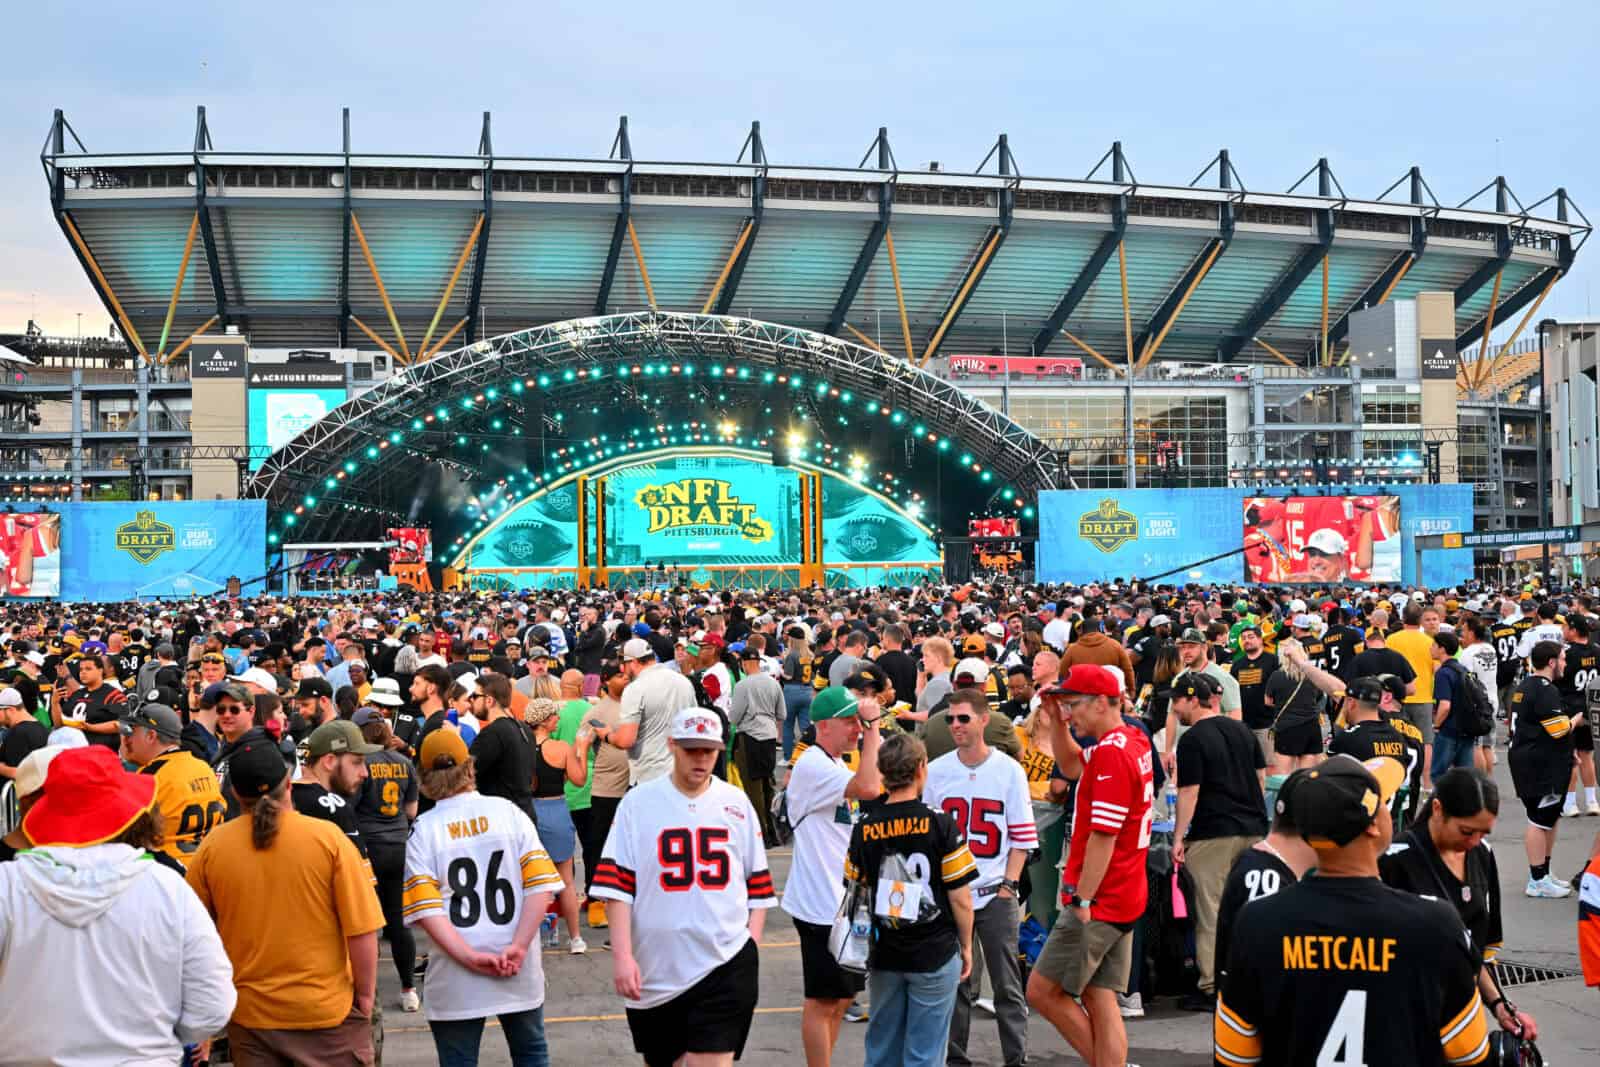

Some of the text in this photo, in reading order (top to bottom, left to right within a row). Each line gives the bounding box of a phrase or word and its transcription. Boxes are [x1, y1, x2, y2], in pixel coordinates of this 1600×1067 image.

[261, 374, 343, 382] ACRISURE STADIUM
[662, 478, 739, 504] NFL
[648, 503, 756, 534] DRAFT
[1083, 523, 1133, 534] DRAFT
[1420, 519, 1452, 531] BUD
[120, 534, 169, 545] DRAFT
[664, 526, 739, 537] PITTSBURGH
[1145, 527, 1177, 537] LIGHT
[1285, 520, 1305, 561] 15
[1330, 645, 1341, 670] 5
[1373, 742, 1403, 756] RAMSEY
[369, 763, 408, 779] BOSWELL
[318, 792, 347, 813] 90
[380, 780, 400, 817] 9
[447, 815, 489, 840] WARD
[863, 816, 930, 842] POLAMALU
[657, 827, 731, 892] 95
[447, 849, 516, 928] 86
[1244, 868, 1281, 901] 90
[1282, 935, 1398, 973] METCALF
[1315, 989, 1369, 1067] 4
